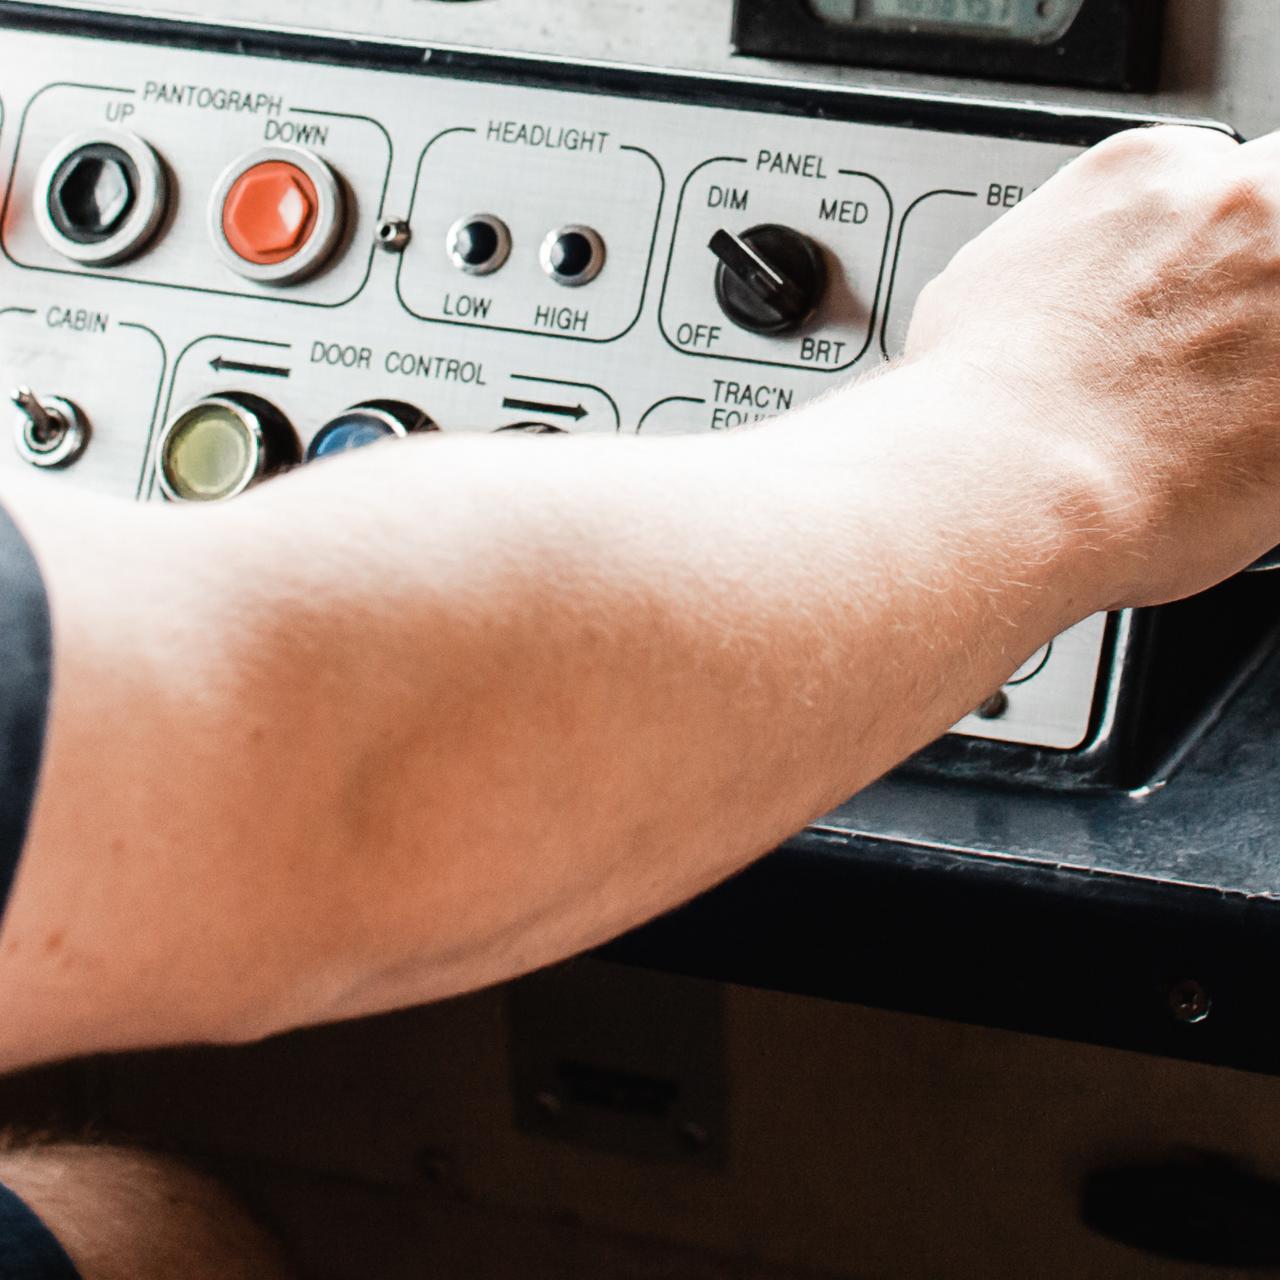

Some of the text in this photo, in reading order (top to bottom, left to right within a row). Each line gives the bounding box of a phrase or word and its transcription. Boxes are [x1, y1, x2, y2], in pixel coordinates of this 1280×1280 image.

[105, 102, 135, 122] UP
[143, 81, 283, 117] PANTOGRAPH
[263, 119, 329, 146] DOWN
[487, 120, 610, 154] HEADLIGHT
[756, 150, 827, 178] PANEL
[707, 186, 869, 224] DIM MED
[46, 306, 108, 332] CABIN
[443, 294, 492, 318] LOW
[535, 306, 588, 331] HIGH
[677, 324, 721, 348] OFF
[310, 341, 486, 385] DOOR CONTROL
[800, 339, 845, 364] BRT
[713, 379, 793, 410] TRAC'N
